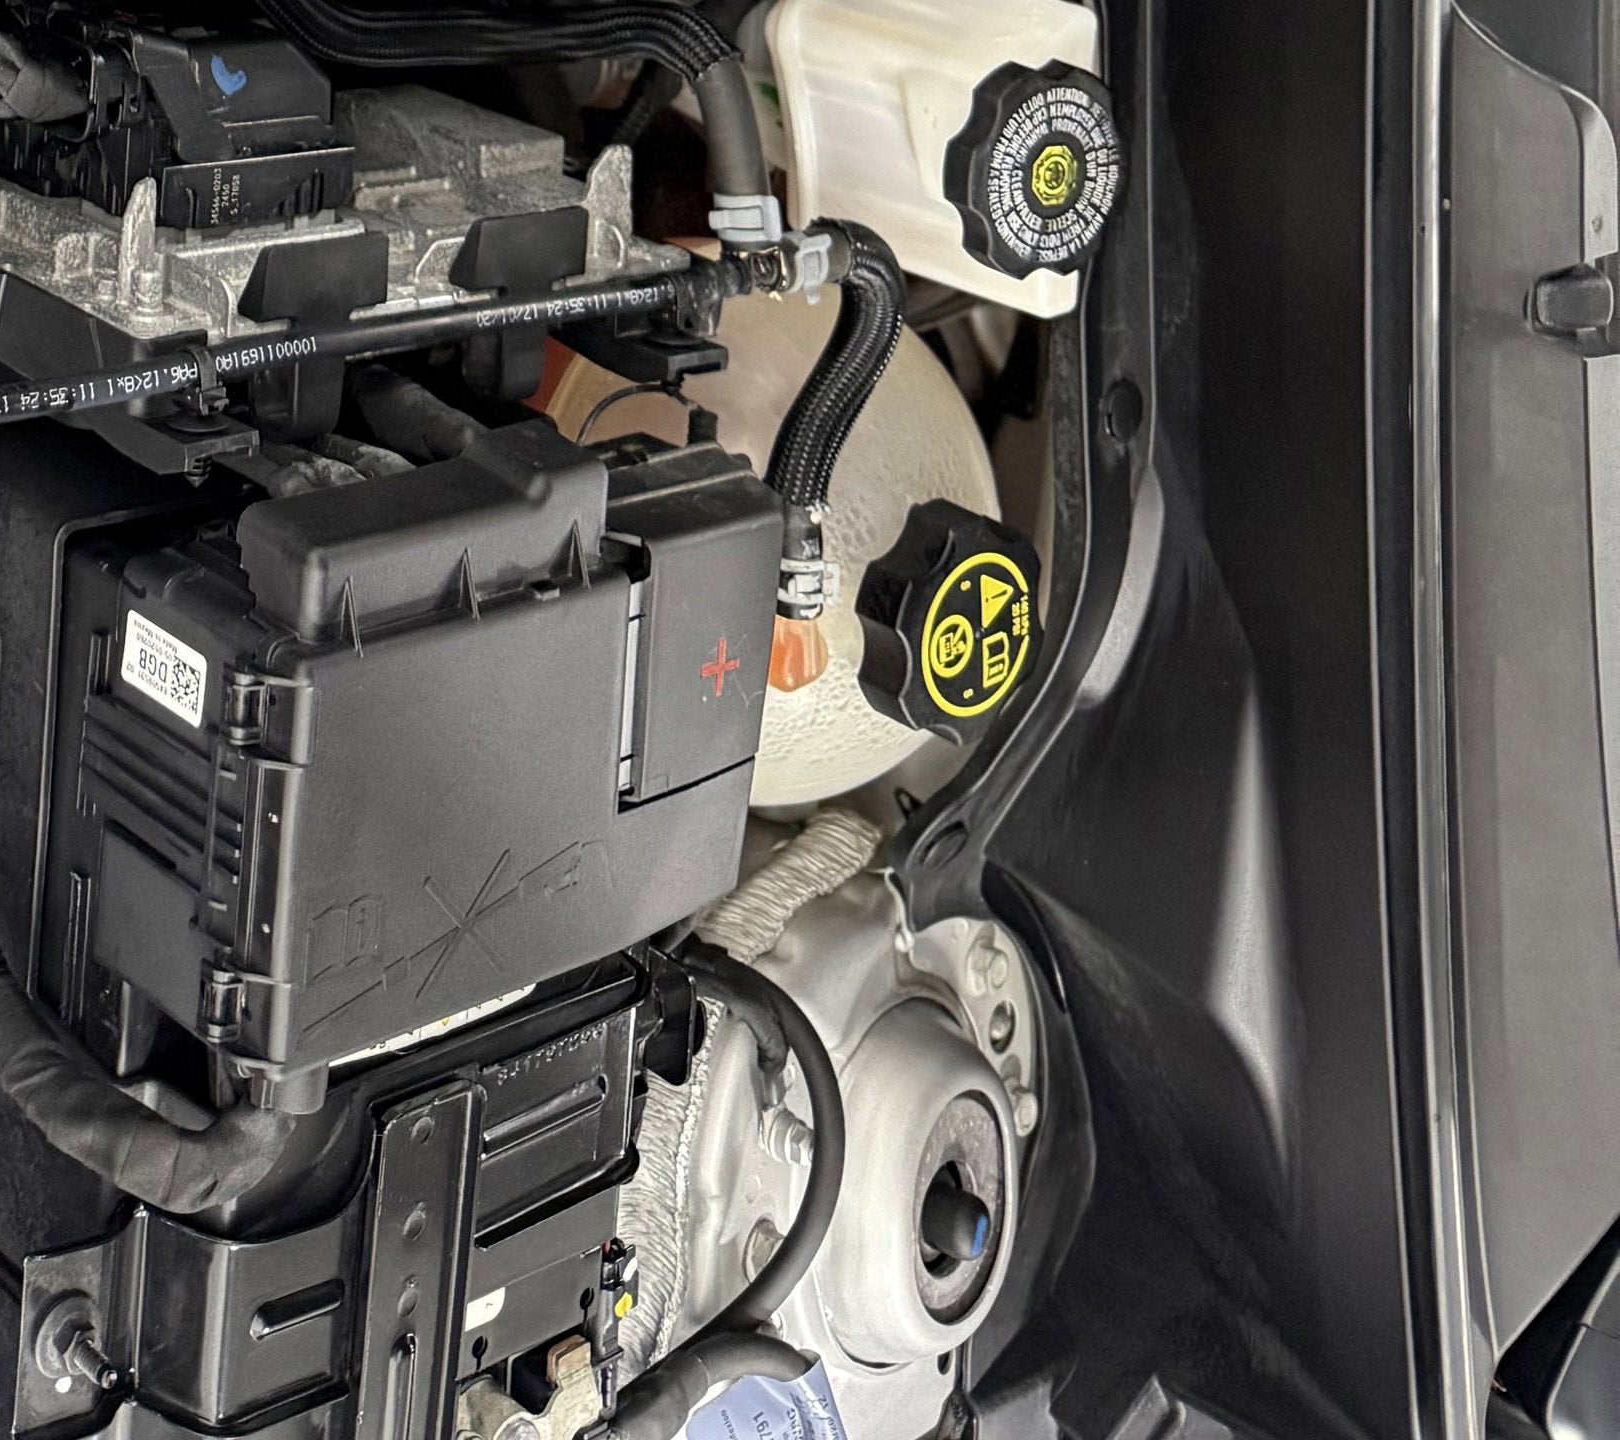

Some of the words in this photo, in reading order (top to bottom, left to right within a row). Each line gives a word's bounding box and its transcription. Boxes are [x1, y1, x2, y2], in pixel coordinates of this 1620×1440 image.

[107, 361, 199, 396] PA6.12<8x1
[19, 382, 96, 411] 11:35:24
[138, 647, 168, 684] DGB
[752, 1410, 777, 1440] 791
